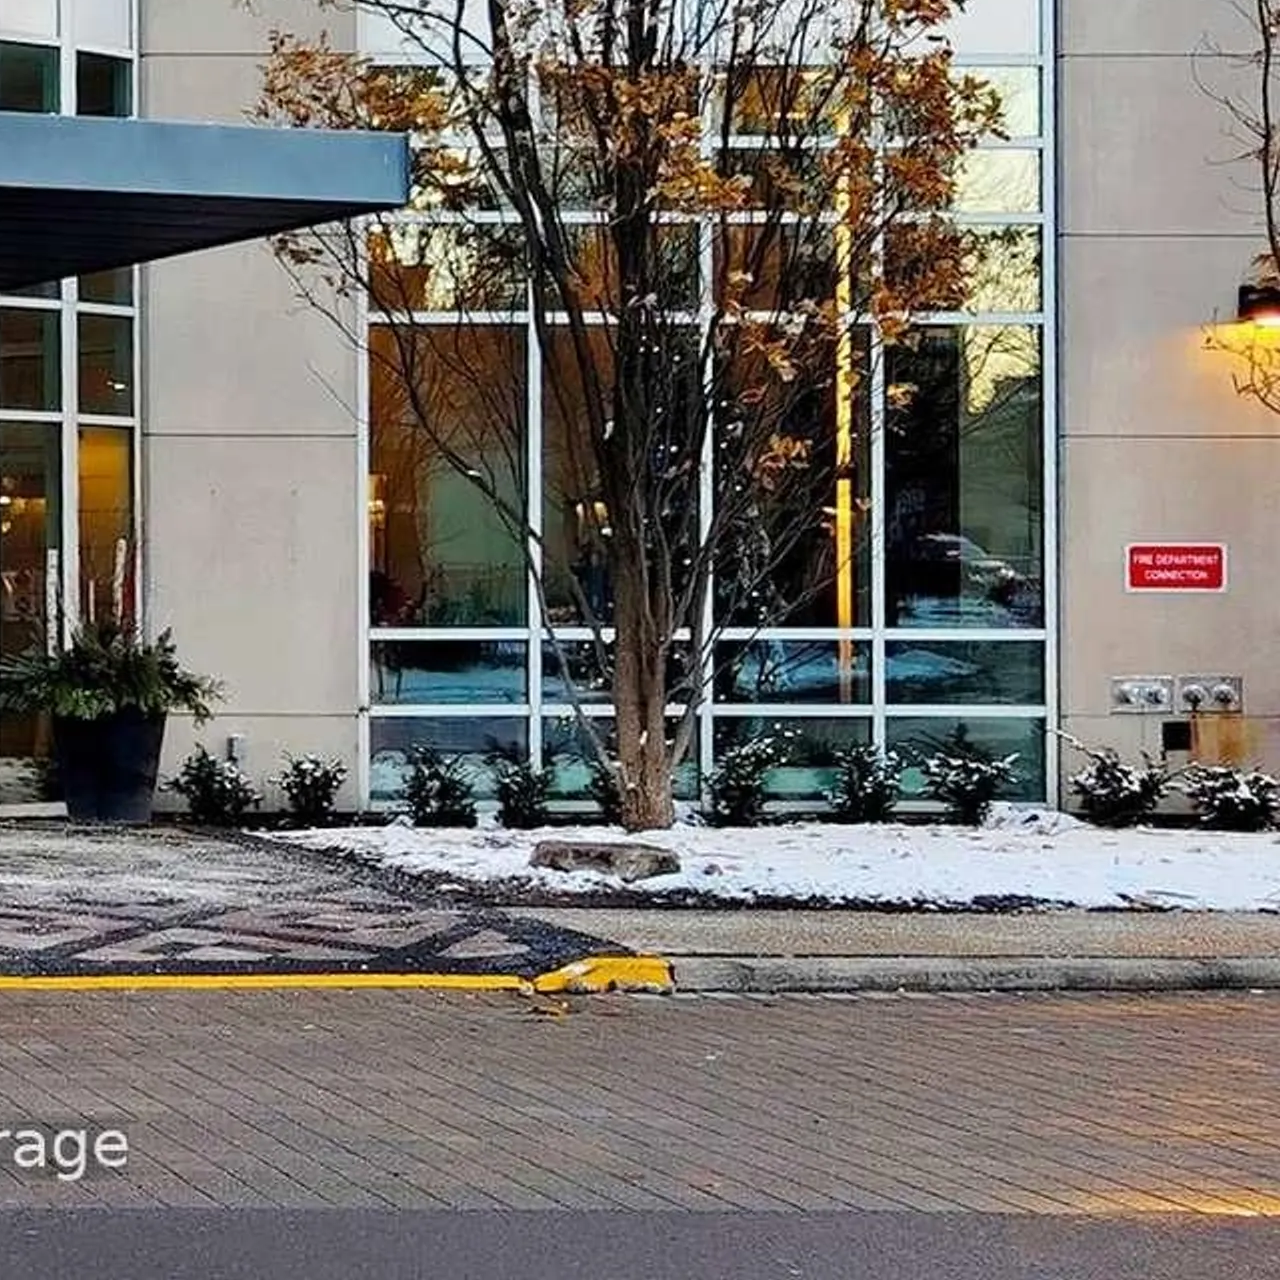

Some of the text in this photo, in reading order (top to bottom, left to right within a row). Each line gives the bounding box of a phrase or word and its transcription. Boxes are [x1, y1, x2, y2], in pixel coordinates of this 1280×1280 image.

[1133, 554, 1218, 566] FIRE DEPARTMENT
[1144, 569, 1208, 580] CONNECTION
